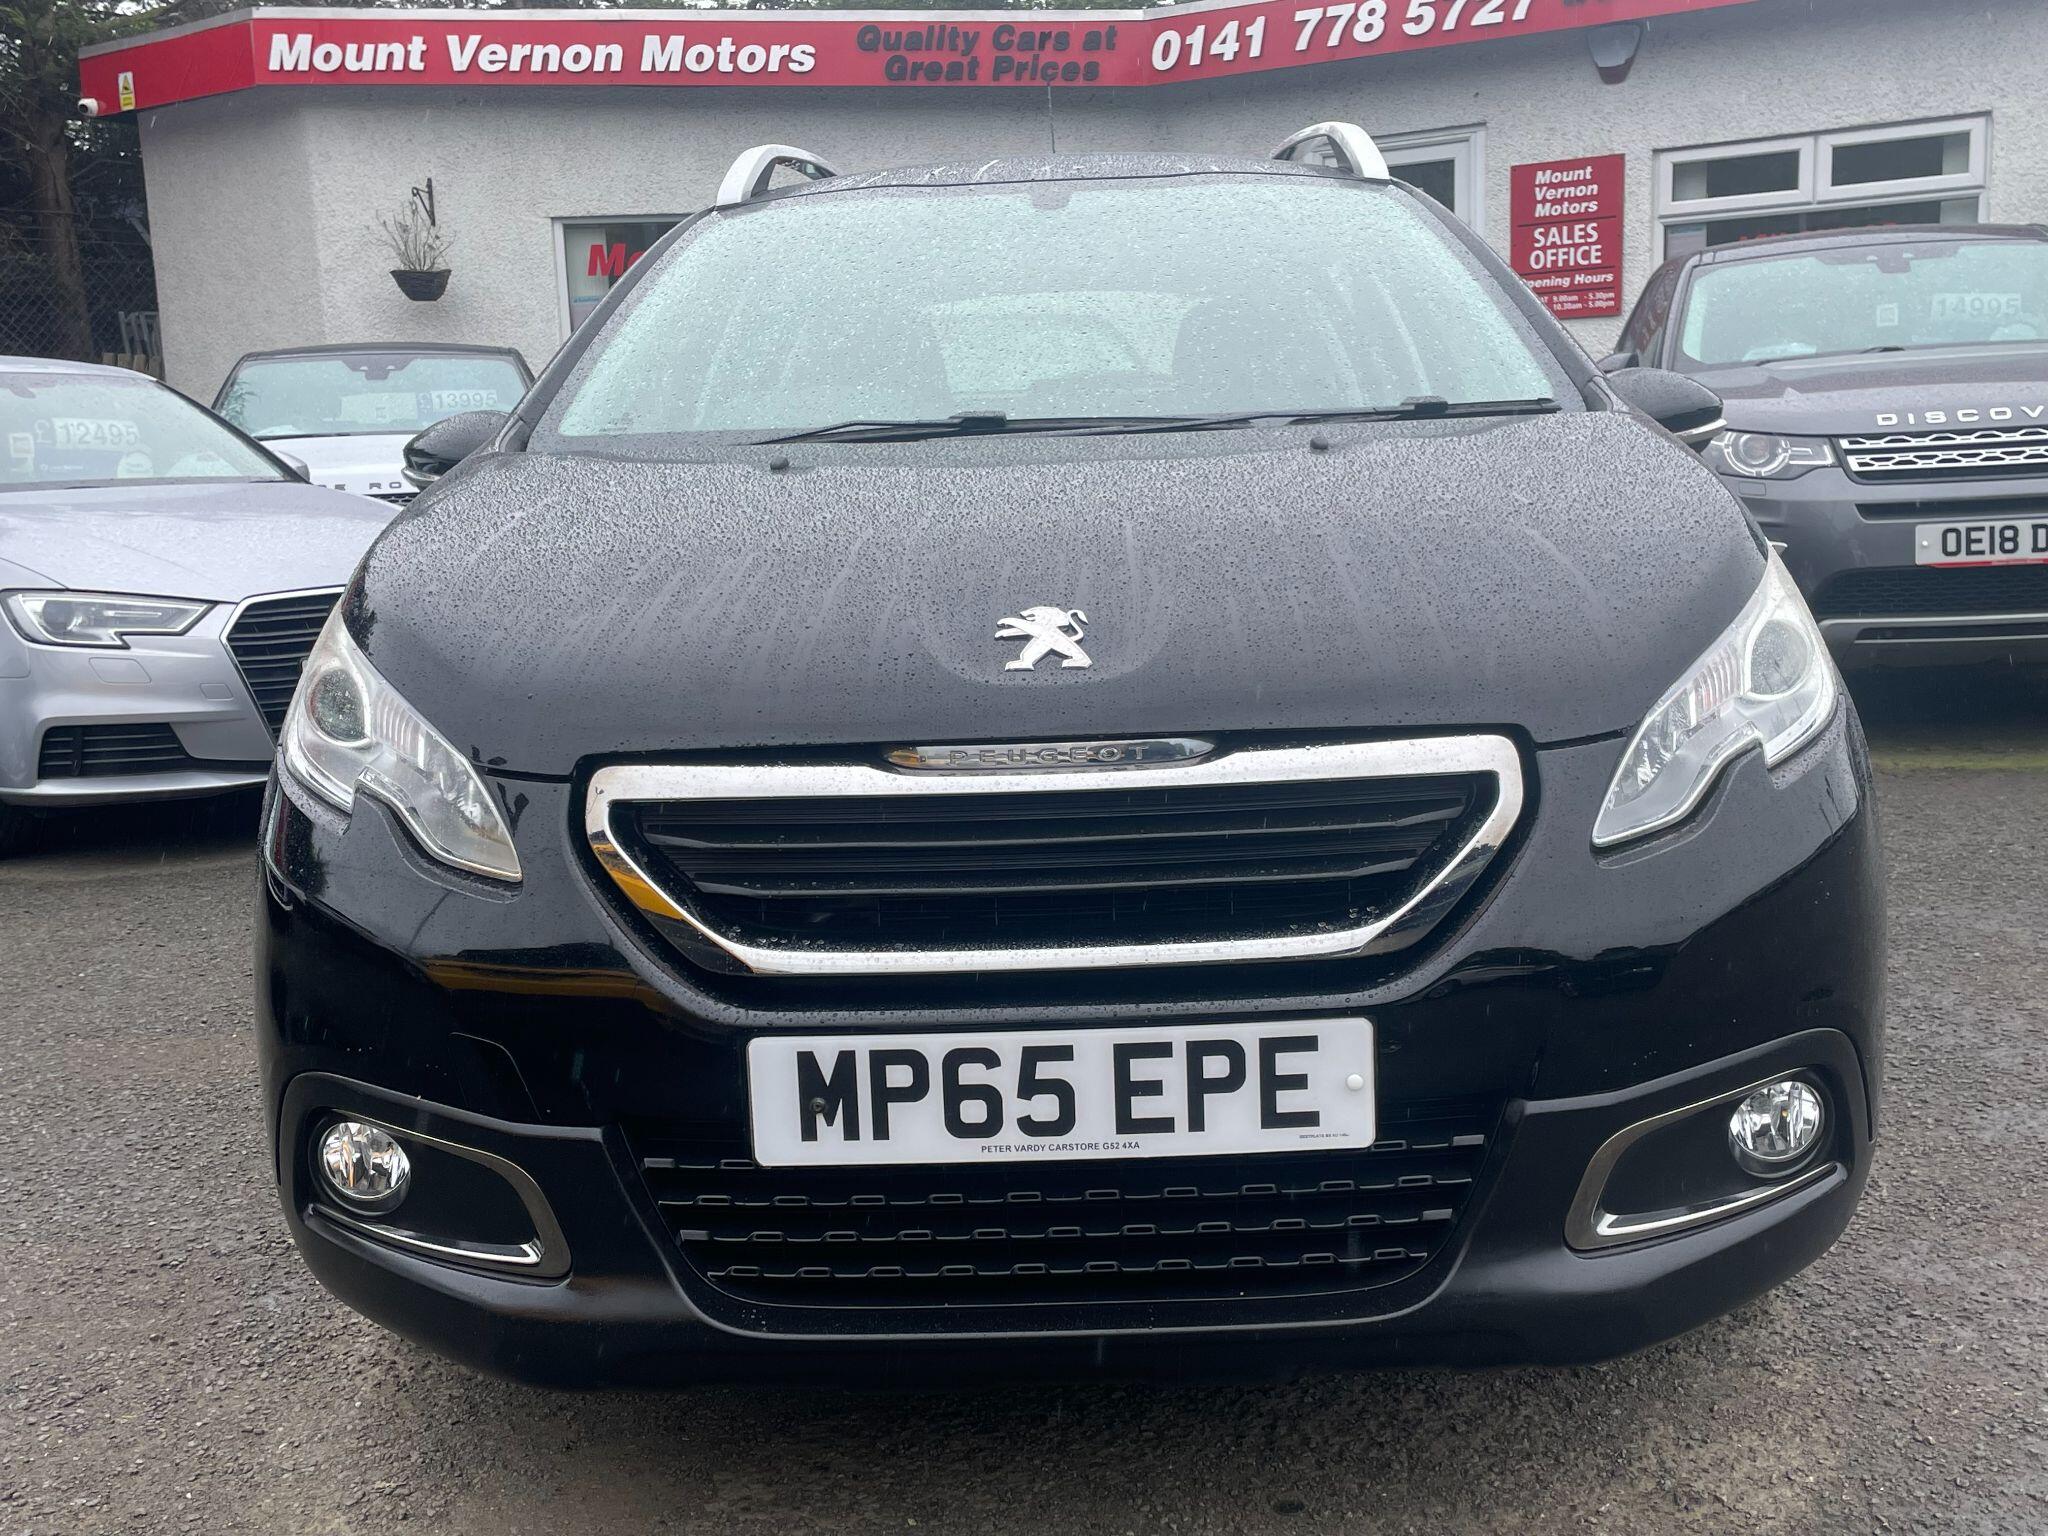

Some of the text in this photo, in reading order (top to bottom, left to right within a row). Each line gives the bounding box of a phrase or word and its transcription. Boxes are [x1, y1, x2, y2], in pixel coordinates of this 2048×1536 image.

[857, 24, 1118, 56] Quality Cars at
[1151, 16, 1266, 71] 0141
[1294, 0, 1388, 51] 778
[268, 33, 816, 73] Mount Vernon Motors
[885, 54, 1100, 82] Great Prices
[1535, 166, 1593, 185] Mount
[1534, 184, 1599, 201] Vernon
[1535, 201, 1599, 217] Motors
[1533, 222, 1599, 248] SALES
[1529, 245, 1603, 270] OFFICE
[1574, 273, 1614, 285] Hours
[1876, 405, 2044, 426] DISCOV
[1941, 525, 2019, 557] OE18
[949, 745, 1150, 765] PEUGEOT
[796, 1035, 1321, 1142] MP65 EPE
[981, 1141, 1140, 1153] PETER VARDY CARSTORE G52 4XA
